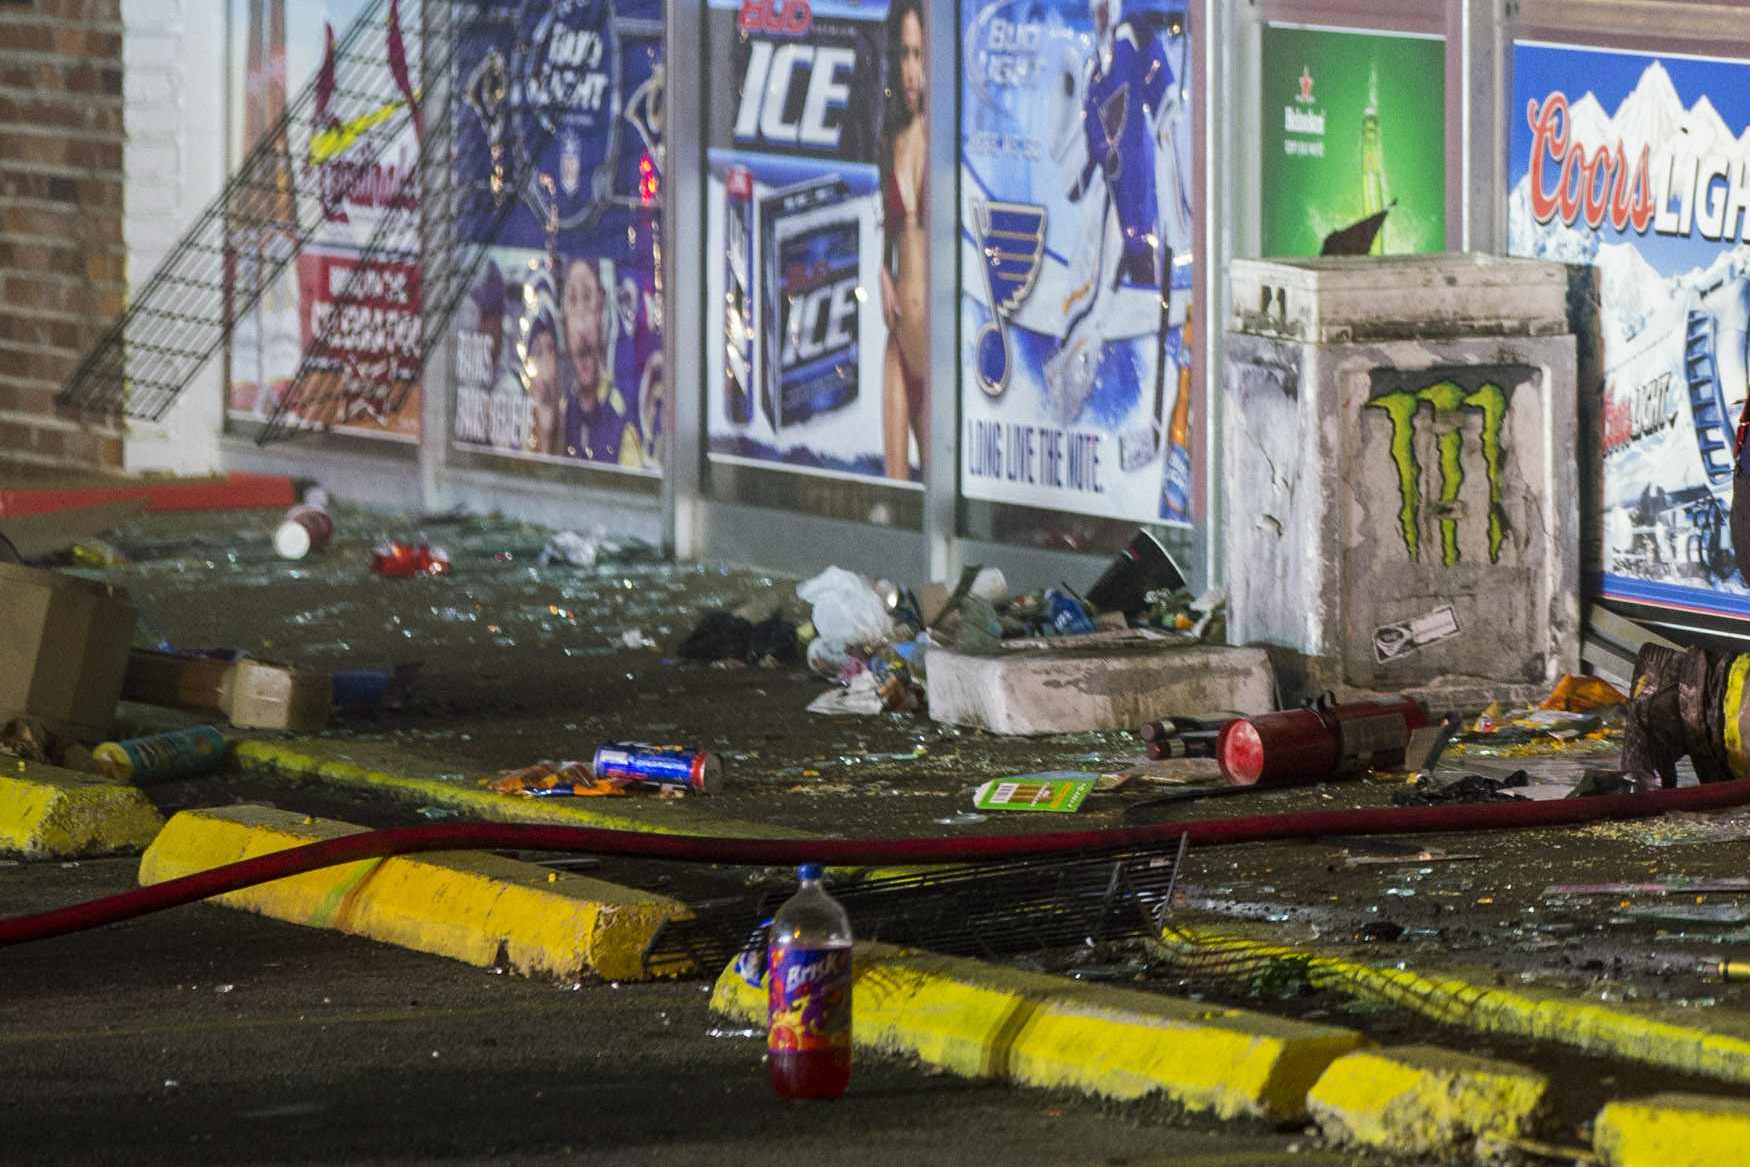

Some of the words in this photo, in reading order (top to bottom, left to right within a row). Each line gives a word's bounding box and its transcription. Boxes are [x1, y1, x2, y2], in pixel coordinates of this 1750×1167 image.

[735, 40, 857, 150] ICE
[1528, 90, 1656, 235] Coors
[782, 277, 860, 368] ICE
[968, 418, 1001, 479] LONG
[1006, 422, 1035, 485] LIVE
[1038, 426, 1063, 489] THE
